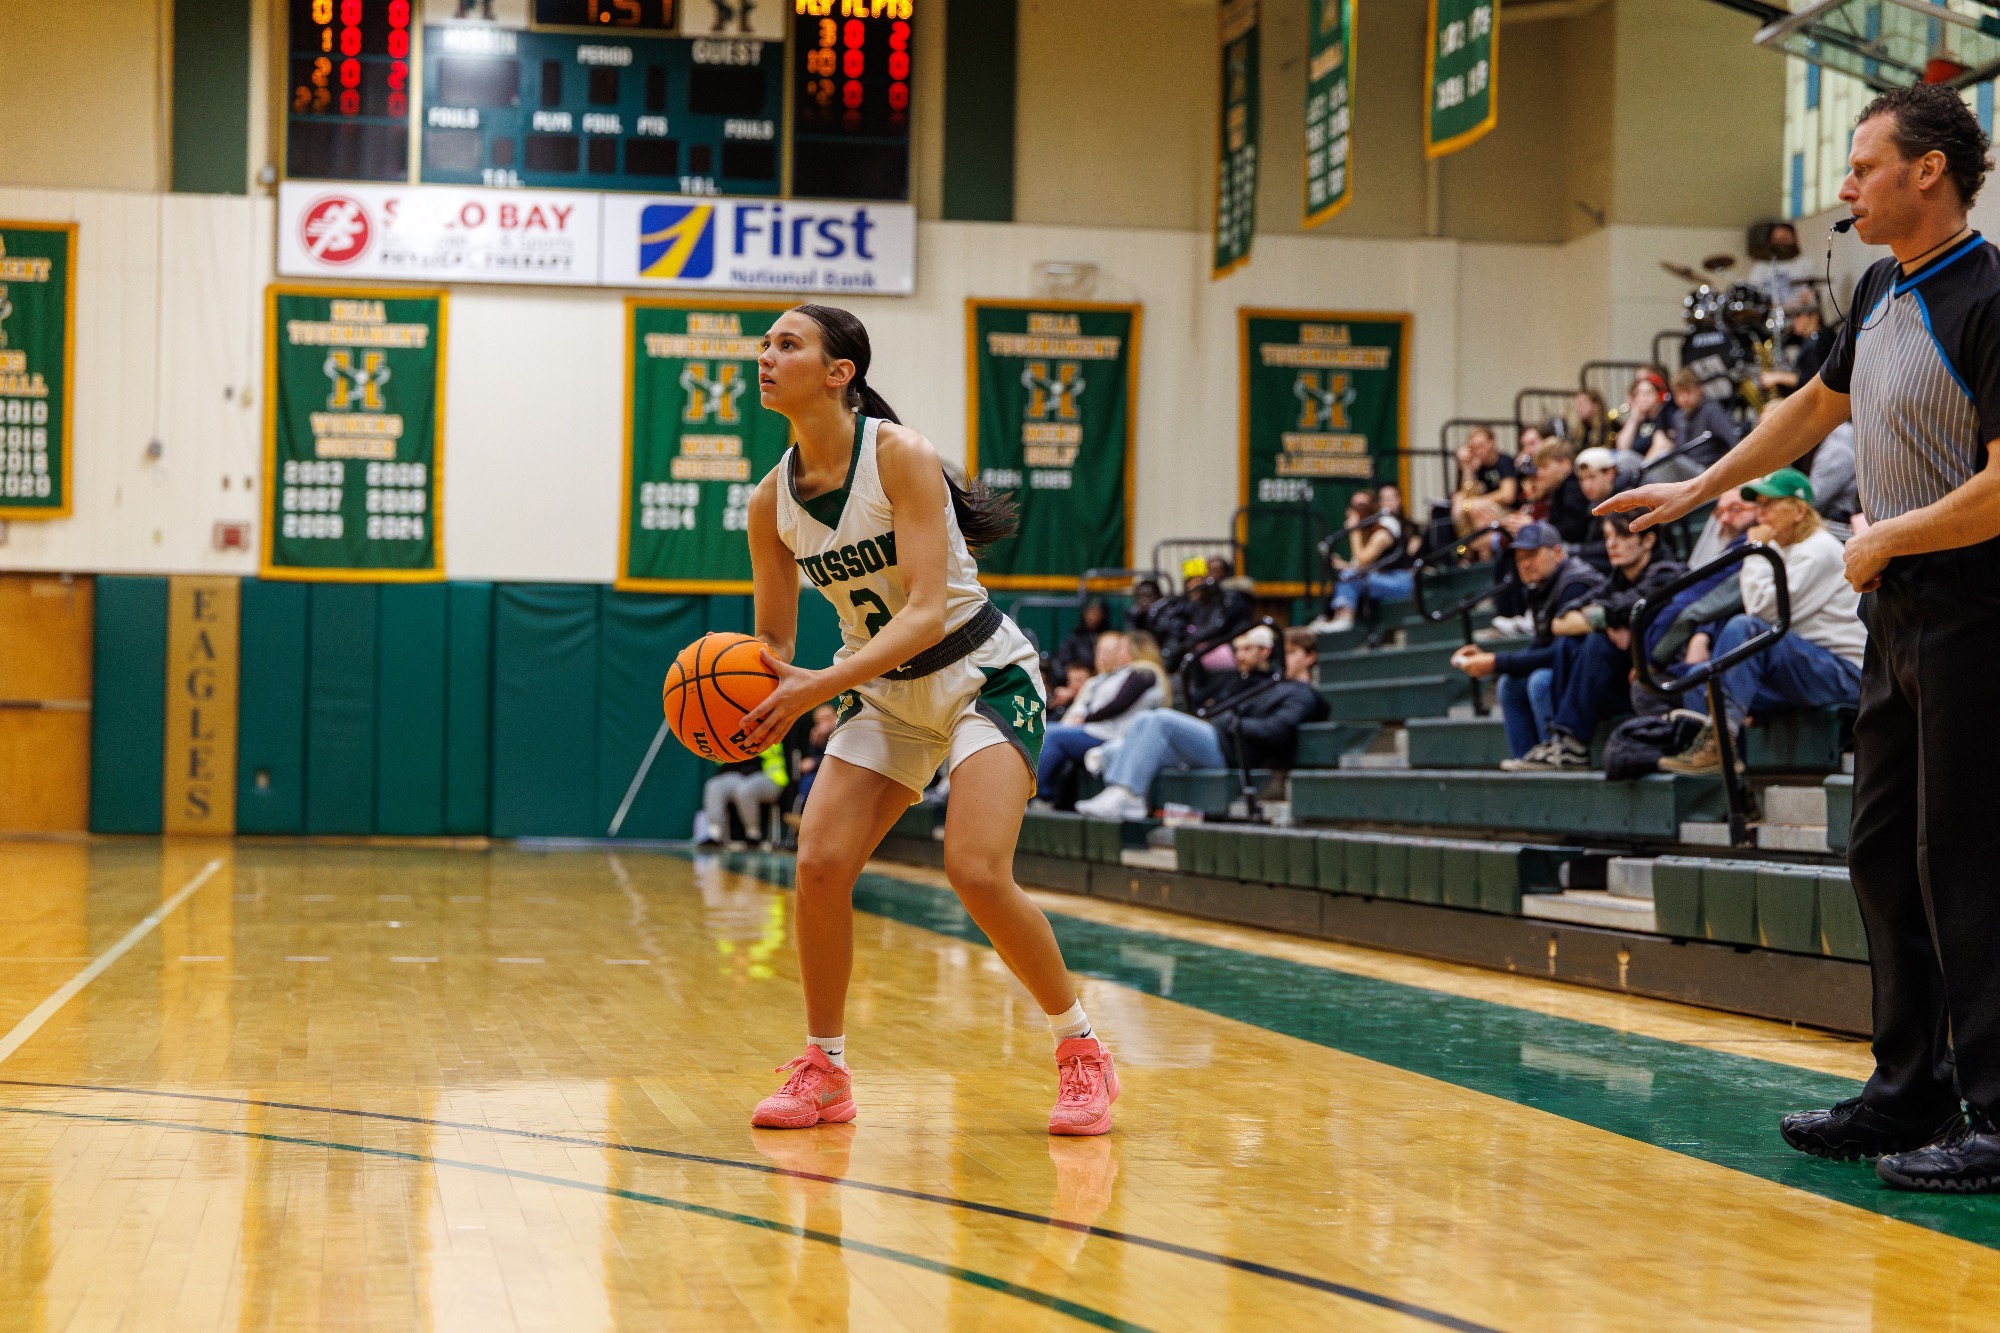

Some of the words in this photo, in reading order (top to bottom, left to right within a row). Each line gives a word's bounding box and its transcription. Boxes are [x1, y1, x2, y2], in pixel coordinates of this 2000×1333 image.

[890, 21, 910, 51] 2
[577, 45, 632, 65] PERIOD
[692, 40, 763, 65] GUEST
[388, 60, 408, 90] 2
[428, 107, 479, 128] FOULS
[533, 111, 571, 131] PLYR
[583, 113, 623, 133] FOUL
[637, 116, 667, 136] PTS
[725, 119, 773, 139] FOULS
[499, 203, 574, 230] BAY
[735, 205, 875, 260] First
[731, 268, 818, 287] National
[824, 271, 875, 288] Bank
[287, 320, 429, 348] TOURNAMENT
[988, 333, 1120, 359] TOURNAMENT
[1260, 344, 1391, 369] TOURNAMENT
[310, 412, 403, 437] WOMENS
[316, 437, 396, 460] SOCCER
[680, 434, 742, 456] MENS
[284, 461, 344, 486] 2003
[671, 457, 751, 481] SOCCER
[1276, 454, 1373, 478] LACROSSE
[284, 487, 343, 513] 2007
[641, 508, 695, 530] 2014
[795, 531, 897, 587] USSON
[850, 588, 893, 639] 2
[185, 588, 216, 820] EAGLES
